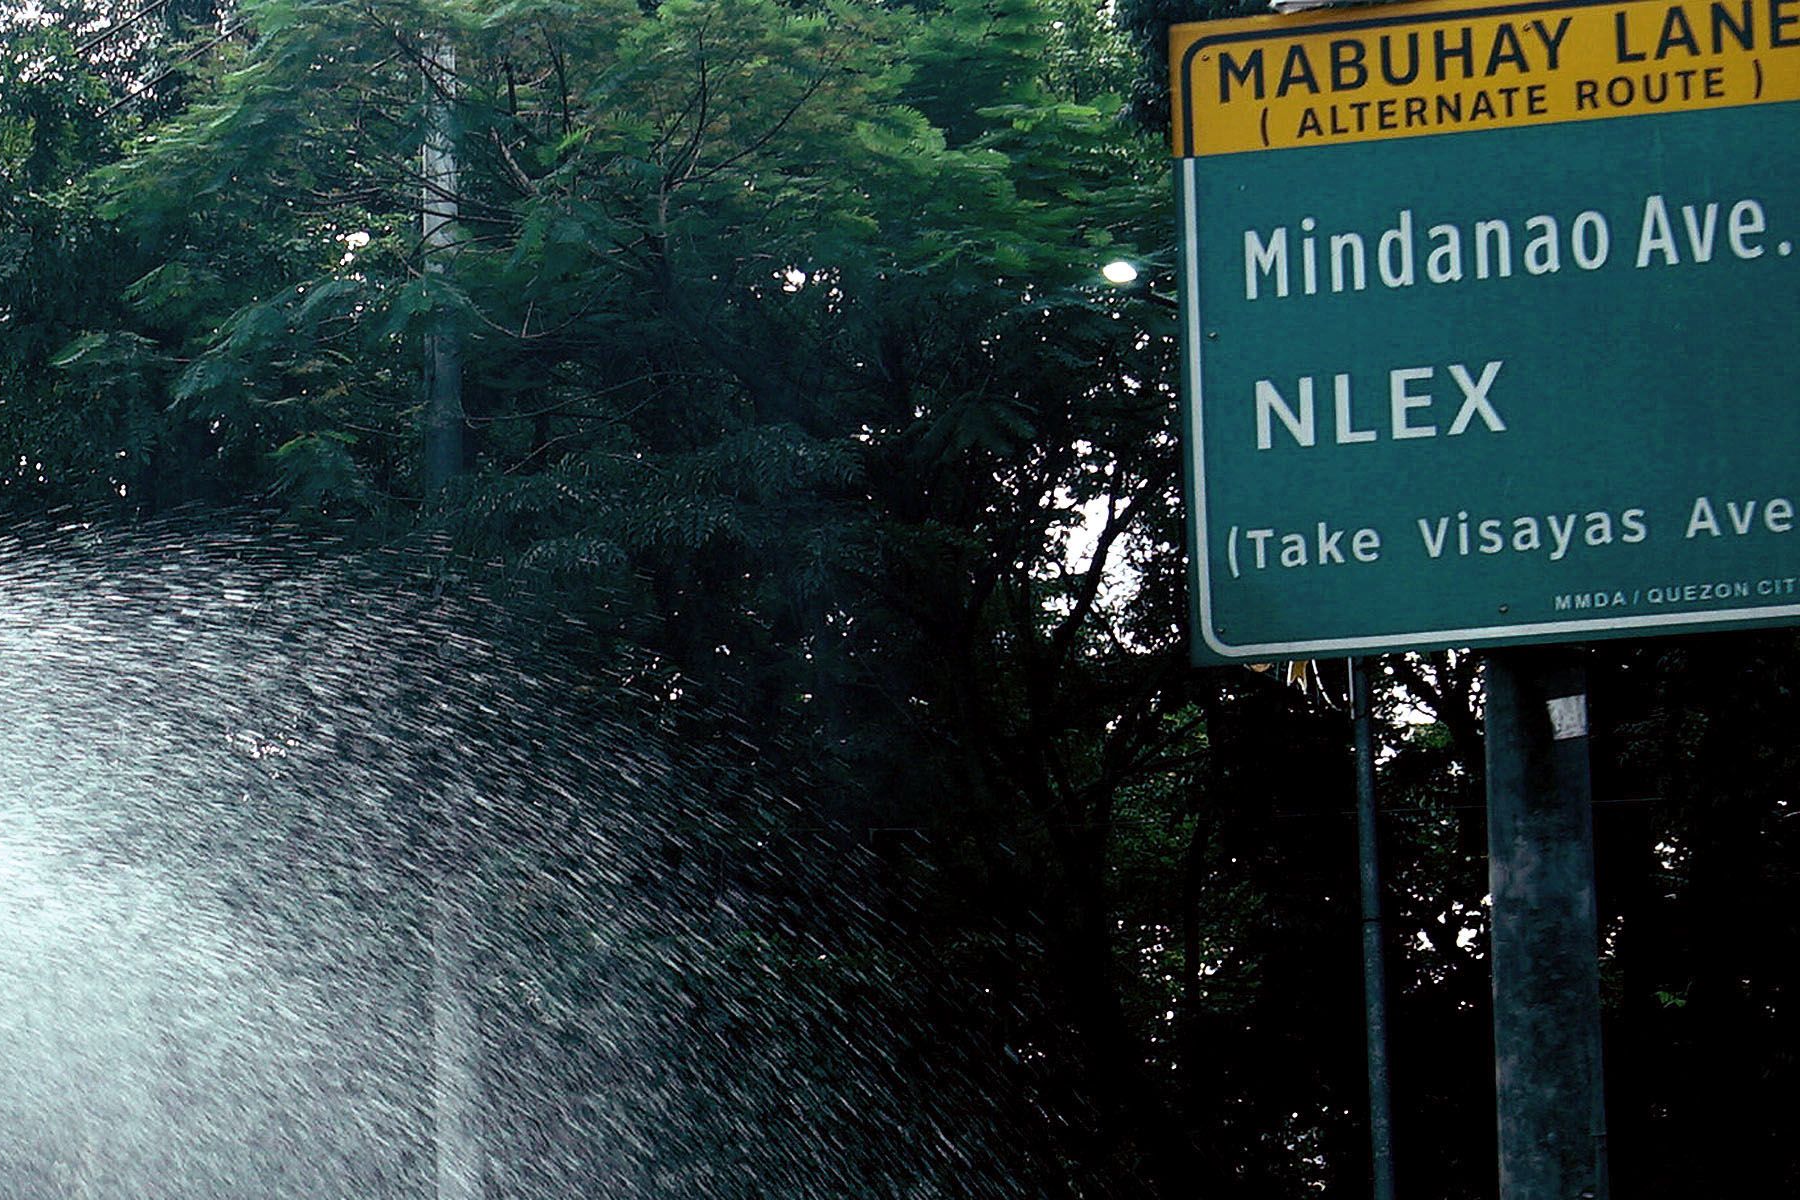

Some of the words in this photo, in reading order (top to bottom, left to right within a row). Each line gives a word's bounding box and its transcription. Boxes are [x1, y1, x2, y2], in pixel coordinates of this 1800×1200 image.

[1218, 16, 1573, 104] MABUHAY
[1614, 0, 1800, 64] LANE
[1244, 208, 1611, 301] Mindanao
[1635, 195, 1792, 268] Ave.
[1255, 360, 1507, 450] NLEX
[1227, 521, 1381, 578] (Take
[1417, 507, 1648, 561] Visayas
[1685, 496, 1796, 539] Ave
[1555, 591, 1627, 611] MMDA
[1647, 581, 1750, 604] QUEZON
[1756, 577, 1800, 596] CIT
